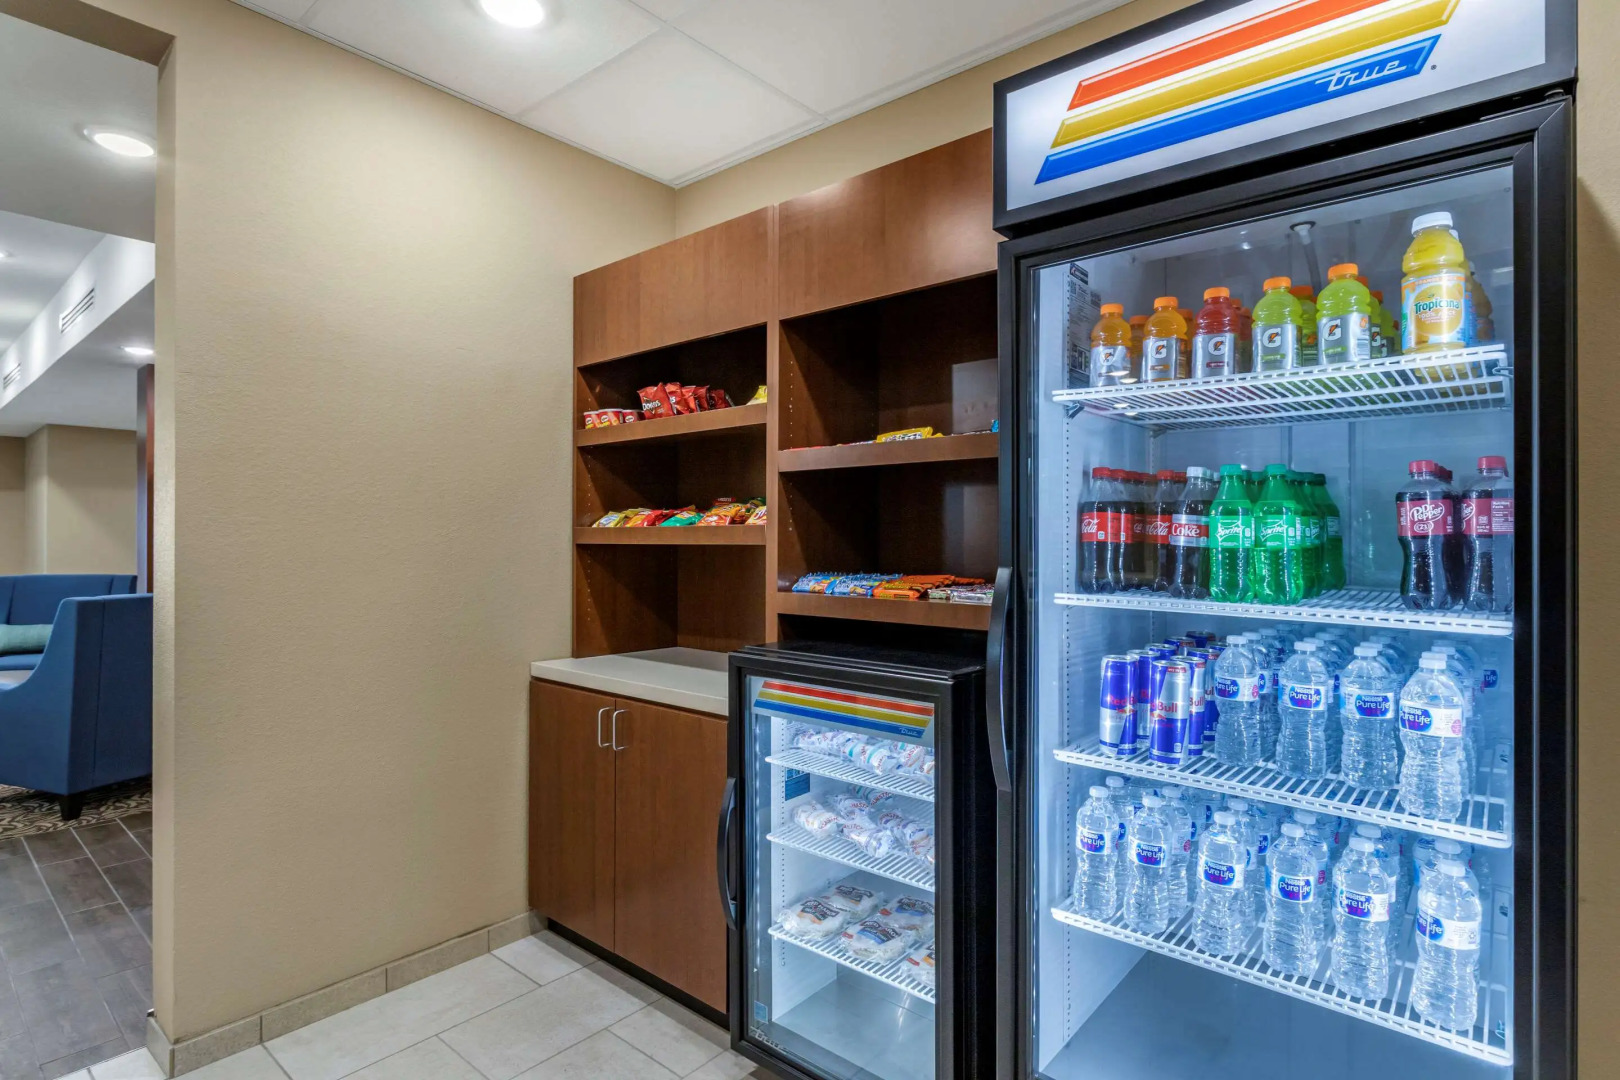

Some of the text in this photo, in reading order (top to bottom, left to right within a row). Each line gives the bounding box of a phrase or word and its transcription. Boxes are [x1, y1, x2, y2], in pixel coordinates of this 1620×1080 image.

[1414, 298, 1461, 315] Tropicana
[1422, 504, 1436, 512] Dr
[1412, 506, 1443, 522] Pepper
[1172, 524, 1200, 538] Coke
[1218, 526, 1242, 537] Sprite
[1261, 526, 1284, 537] Sprite
[1225, 684, 1239, 693] Life
[1290, 691, 1321, 703] Pure Life
[1157, 702, 1178, 713] Bull
[1356, 700, 1390, 711] Pure Life
[1415, 715, 1431, 725] Life
[1093, 838, 1105, 848] Life
[1136, 847, 1165, 861] Pure Life
[1204, 864, 1234, 880] Pure Life
[1279, 881, 1311, 896] Pure Life
[1358, 901, 1374, 913] Life
